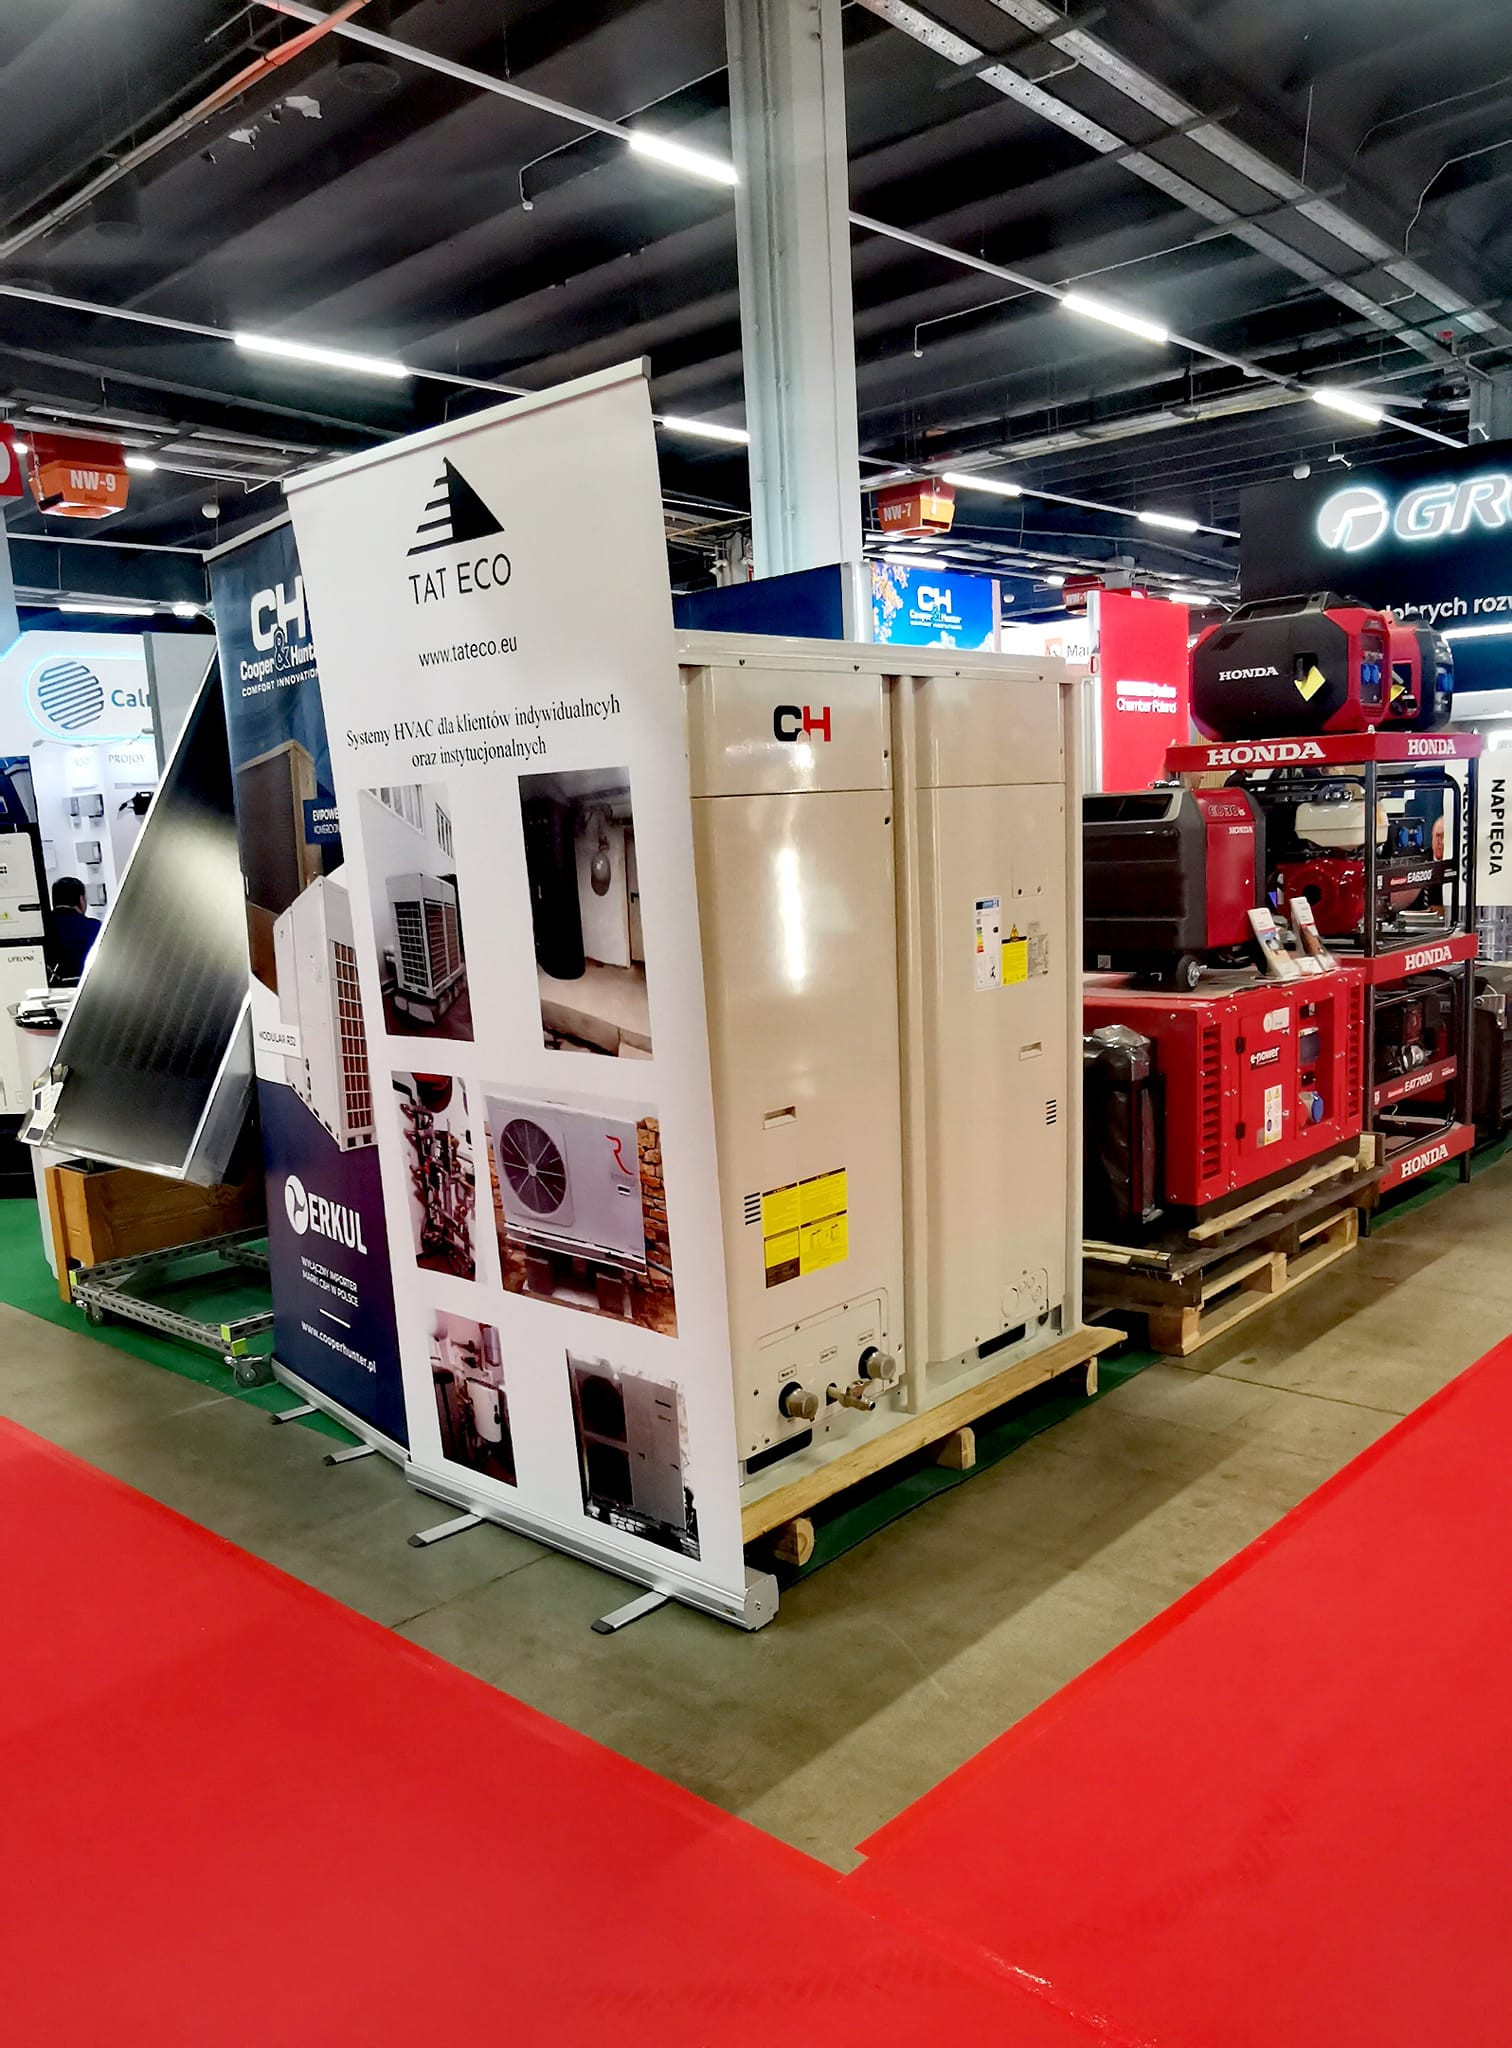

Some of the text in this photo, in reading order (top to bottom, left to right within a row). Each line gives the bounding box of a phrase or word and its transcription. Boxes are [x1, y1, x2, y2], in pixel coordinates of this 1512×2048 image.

[70, 469, 117, 492] NW-9
[883, 502, 912, 522] NW-7
[1394, 474, 1512, 540] GR
[408, 553, 512, 605] TAT ECO
[251, 575, 306, 651] CH
[917, 585, 952, 614] CH
[418, 635, 518, 667] www.tateco.eu
[240, 657, 275, 682] Cooper
[1218, 666, 1279, 681] HONDA
[242, 680, 275, 697] COMFORT
[346, 693, 621, 751] Systemy HVAC dla klientów indywidualncyh
[773, 705, 831, 742] CH
[411, 735, 547, 768] oraz instytucjonalnych
[1207, 742, 1326, 767] HONDA
[1407, 739, 1457, 756] HONDA
[1488, 779, 1506, 876] NAPIĘCIA
[1407, 869, 1433, 884] EA6200
[1404, 945, 1453, 972] HONDA
[1250, 1047, 1280, 1065] e-power
[1400, 1143, 1449, 1179] HONDA
[307, 1192, 368, 1255] ERKUL
[337, 1287, 360, 1307] POLSCE
[301, 1319, 377, 1374] www.cooperhunter.pl
